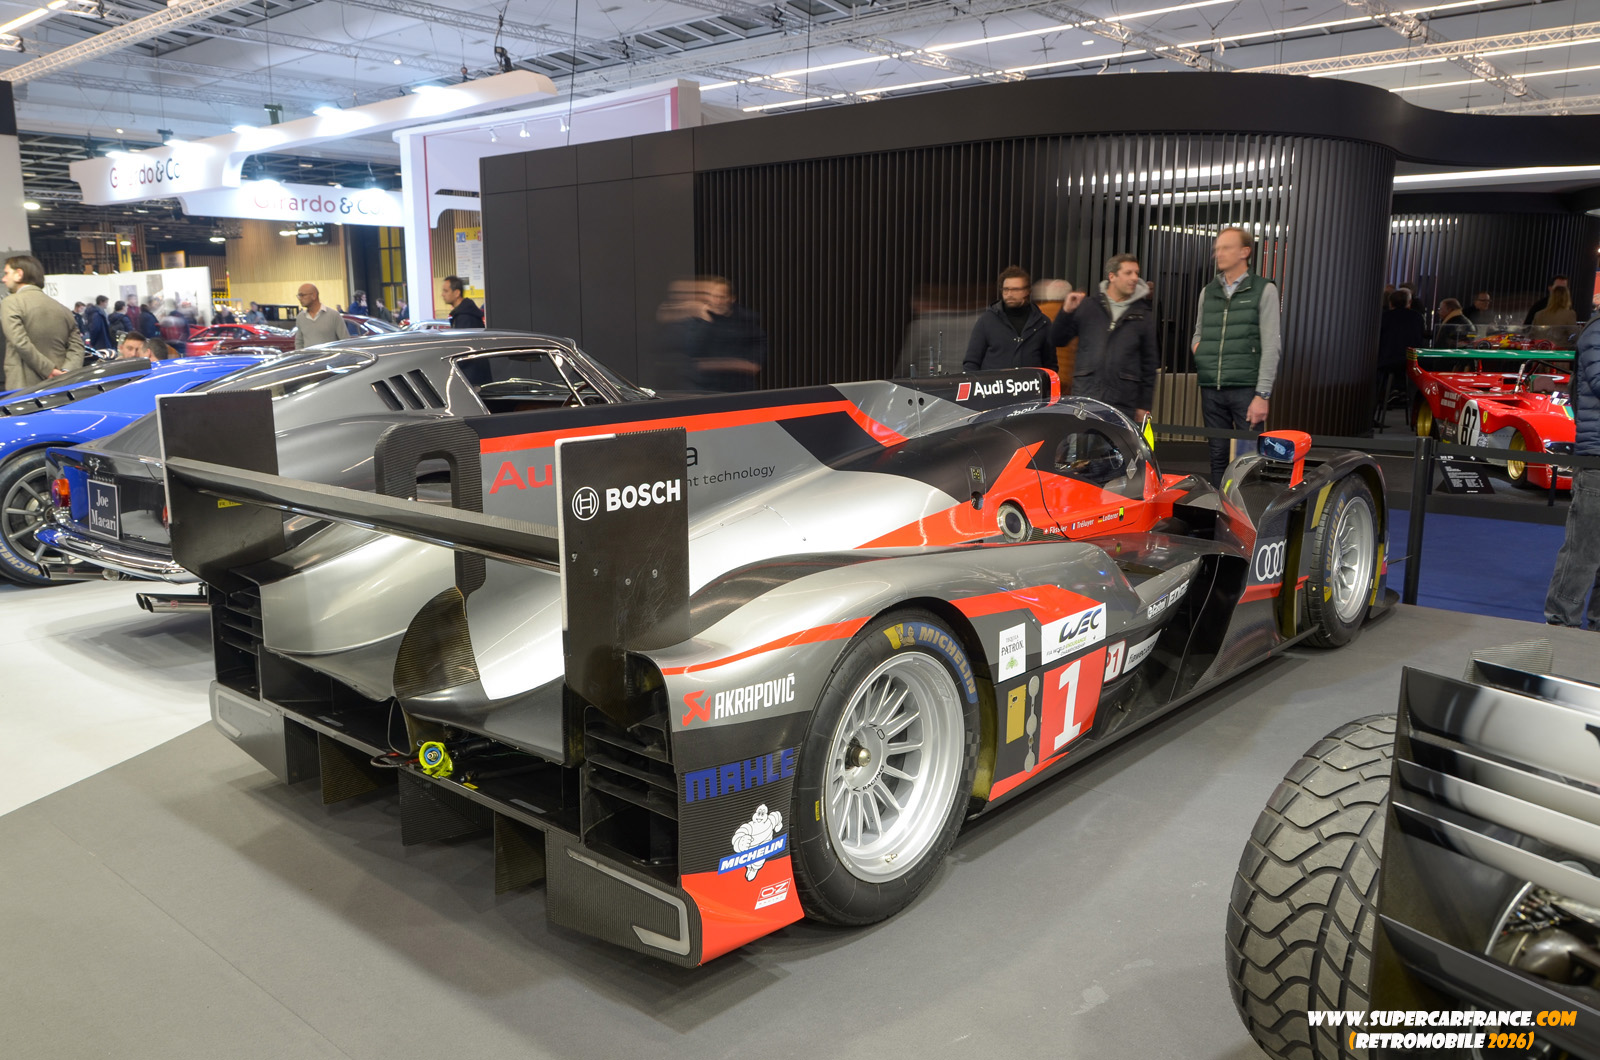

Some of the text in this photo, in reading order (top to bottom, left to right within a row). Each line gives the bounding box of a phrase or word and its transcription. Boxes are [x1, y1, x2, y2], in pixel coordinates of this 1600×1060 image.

[974, 378, 1040, 398] Audi Sport
[489, 461, 554, 495] Au
[703, 464, 776, 486] technology
[96, 490, 109, 508] Joe
[606, 479, 681, 512] BOSCH
[91, 509, 117, 531] Macari
[1059, 608, 1102, 643] WEC
[918, 626, 977, 695] MICHELIN
[715, 673, 795, 719] AKRAPOVIČ
[1054, 660, 1081, 751] 1
[685, 748, 794, 803] MAHLE
[862, 765, 885, 791] RACING
[721, 838, 784, 871] MICHELIN
